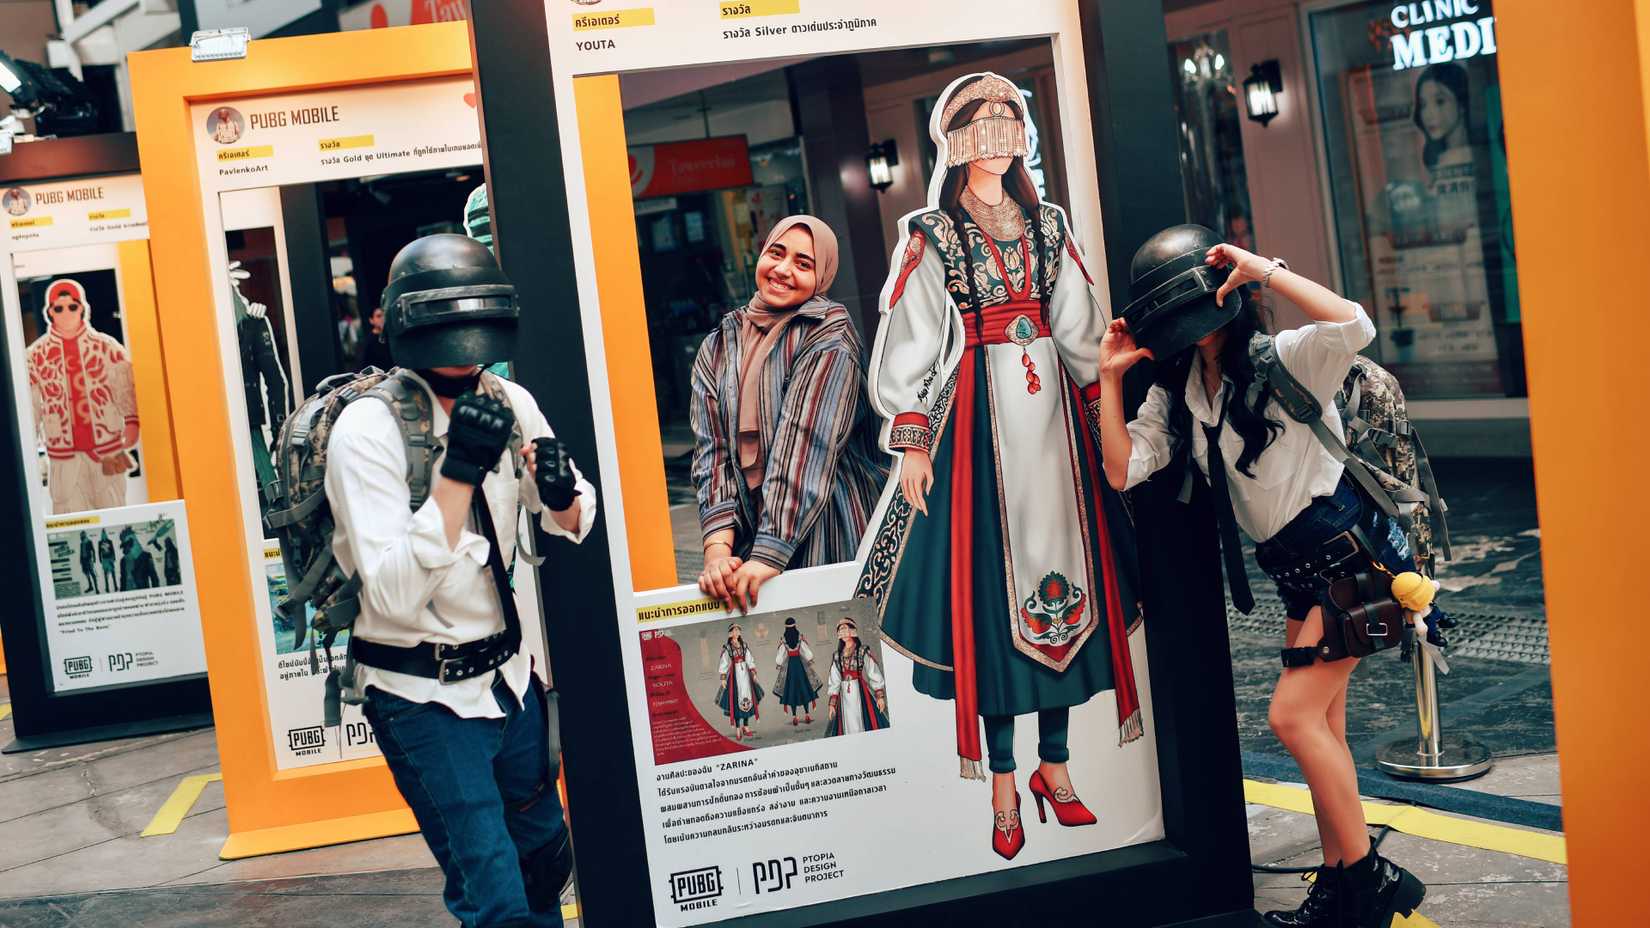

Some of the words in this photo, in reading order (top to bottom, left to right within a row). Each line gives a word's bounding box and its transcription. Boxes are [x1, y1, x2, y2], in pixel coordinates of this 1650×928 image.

[722, 4, 751, 15] รางวัล
[1390, 0, 1479, 28] CLINIC
[575, 13, 620, 27] ครีเอเตอร์
[723, 27, 751, 39] รางวัล
[755, 25, 787, 36] Silver
[791, 18, 877, 33] ดาวเด่นประจำภูมิภาค
[576, 40, 615, 51] YOUTA
[250, 111, 287, 129] PUBG
[290, 106, 340, 125] MOBILE
[343, 154, 362, 163] Gold
[376, 150, 411, 160] Ultimate
[219, 165, 269, 176] PavlenkoArt
[35, 191, 64, 205] PUBG
[67, 186, 104, 202] MOBILE
[638, 601, 721, 620] แนะนำการออกแบบ
[68, 659, 89, 672] PUBG
[293, 729, 320, 747] PUBG
[296, 748, 321, 756] MOBILE
[802, 852, 835, 864] PTOPIA
[803, 861, 837, 873] DESIGN
[804, 870, 845, 883] PROJECT
[677, 872, 716, 897] PUBG
[680, 898, 718, 912] MOBILE
